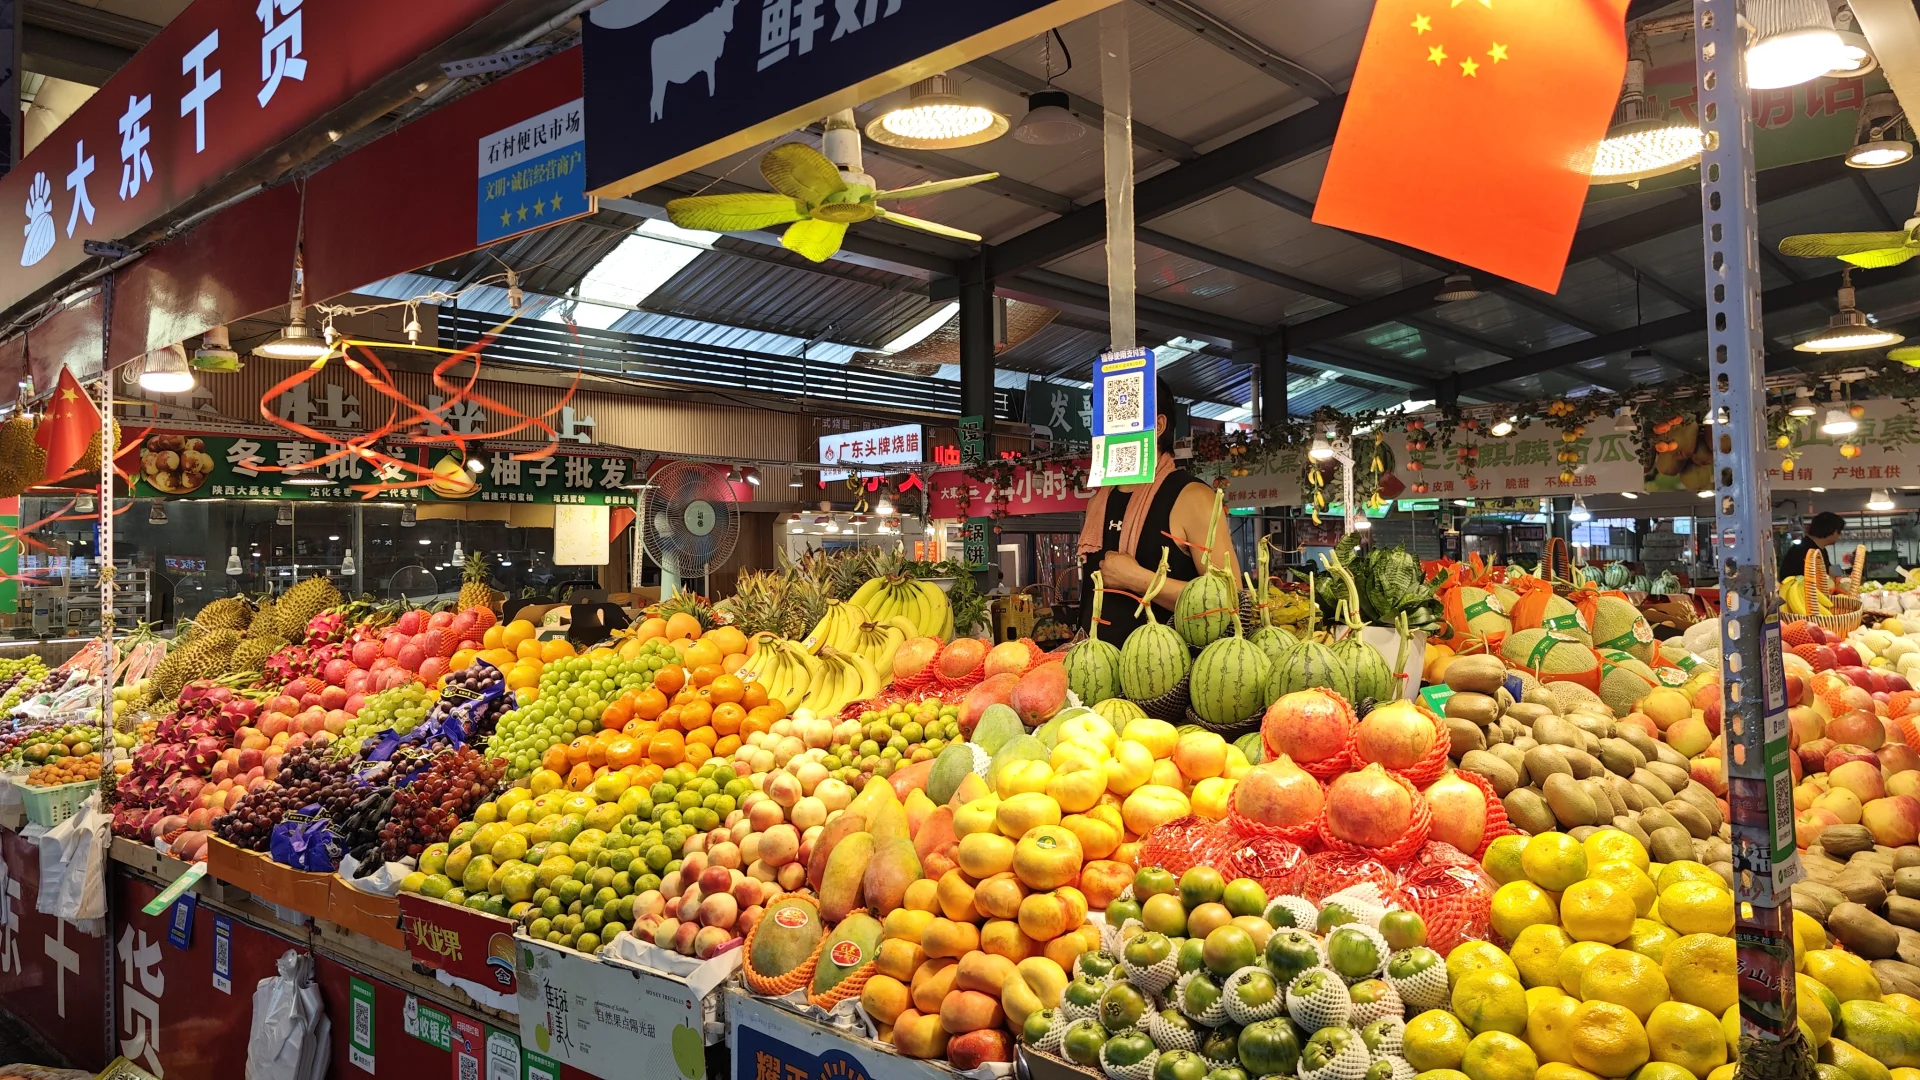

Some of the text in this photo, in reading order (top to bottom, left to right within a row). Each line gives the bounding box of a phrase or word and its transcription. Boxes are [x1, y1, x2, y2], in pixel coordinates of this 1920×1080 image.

[66, 0, 308, 239] 大东干货
[487, 110, 581, 164] 石村便民市场
[484, 150, 582, 203] 文明·诚信经营商户
[226, 438, 407, 482] 冬枣批发
[838, 433, 919, 460] 广东头牌烧腊
[961, 421, 981, 463] 馒头
[490, 451, 628, 490] 柚子批发
[1432, 480, 1455, 493] 皮薄
[1505, 477, 1530, 490] 脆甜
[1832, 465, 1901, 480] 产地直供
[211, 484, 283, 497] 陕西大荔冬枣
[481, 491, 535, 503] 福建平和蜜柚
[1228, 488, 1279, 501] 新鲜大樱桃
[965, 523, 985, 564] 锅饼
[412, 916, 463, 962] 火龙果
[419, 1016, 451, 1048] 收银台
